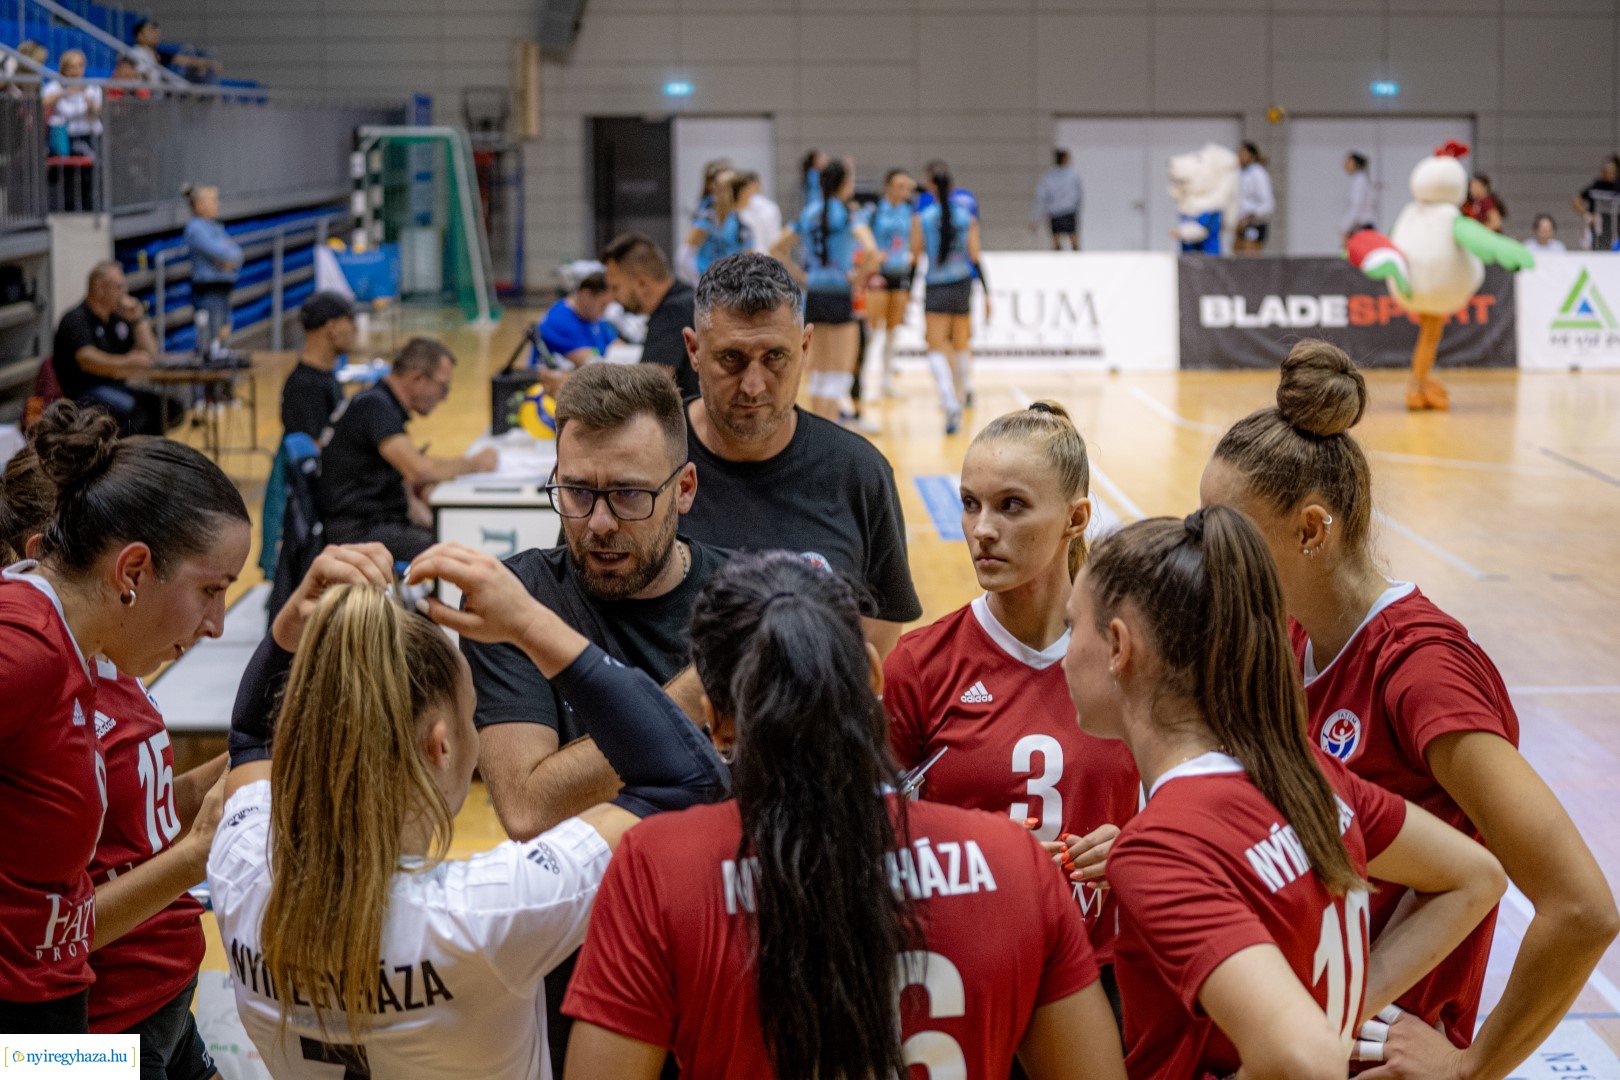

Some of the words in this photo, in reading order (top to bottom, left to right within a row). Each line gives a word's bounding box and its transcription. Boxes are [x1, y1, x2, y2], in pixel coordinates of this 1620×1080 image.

[1200, 295, 1496, 327] BLADESPT
[961, 694, 993, 703] adidas
[1337, 712, 1357, 723] FATUM
[138, 729, 181, 855] 15
[1010, 734, 1064, 842] 3
[36, 894, 95, 949] FAT
[1312, 889, 1370, 1055] 10
